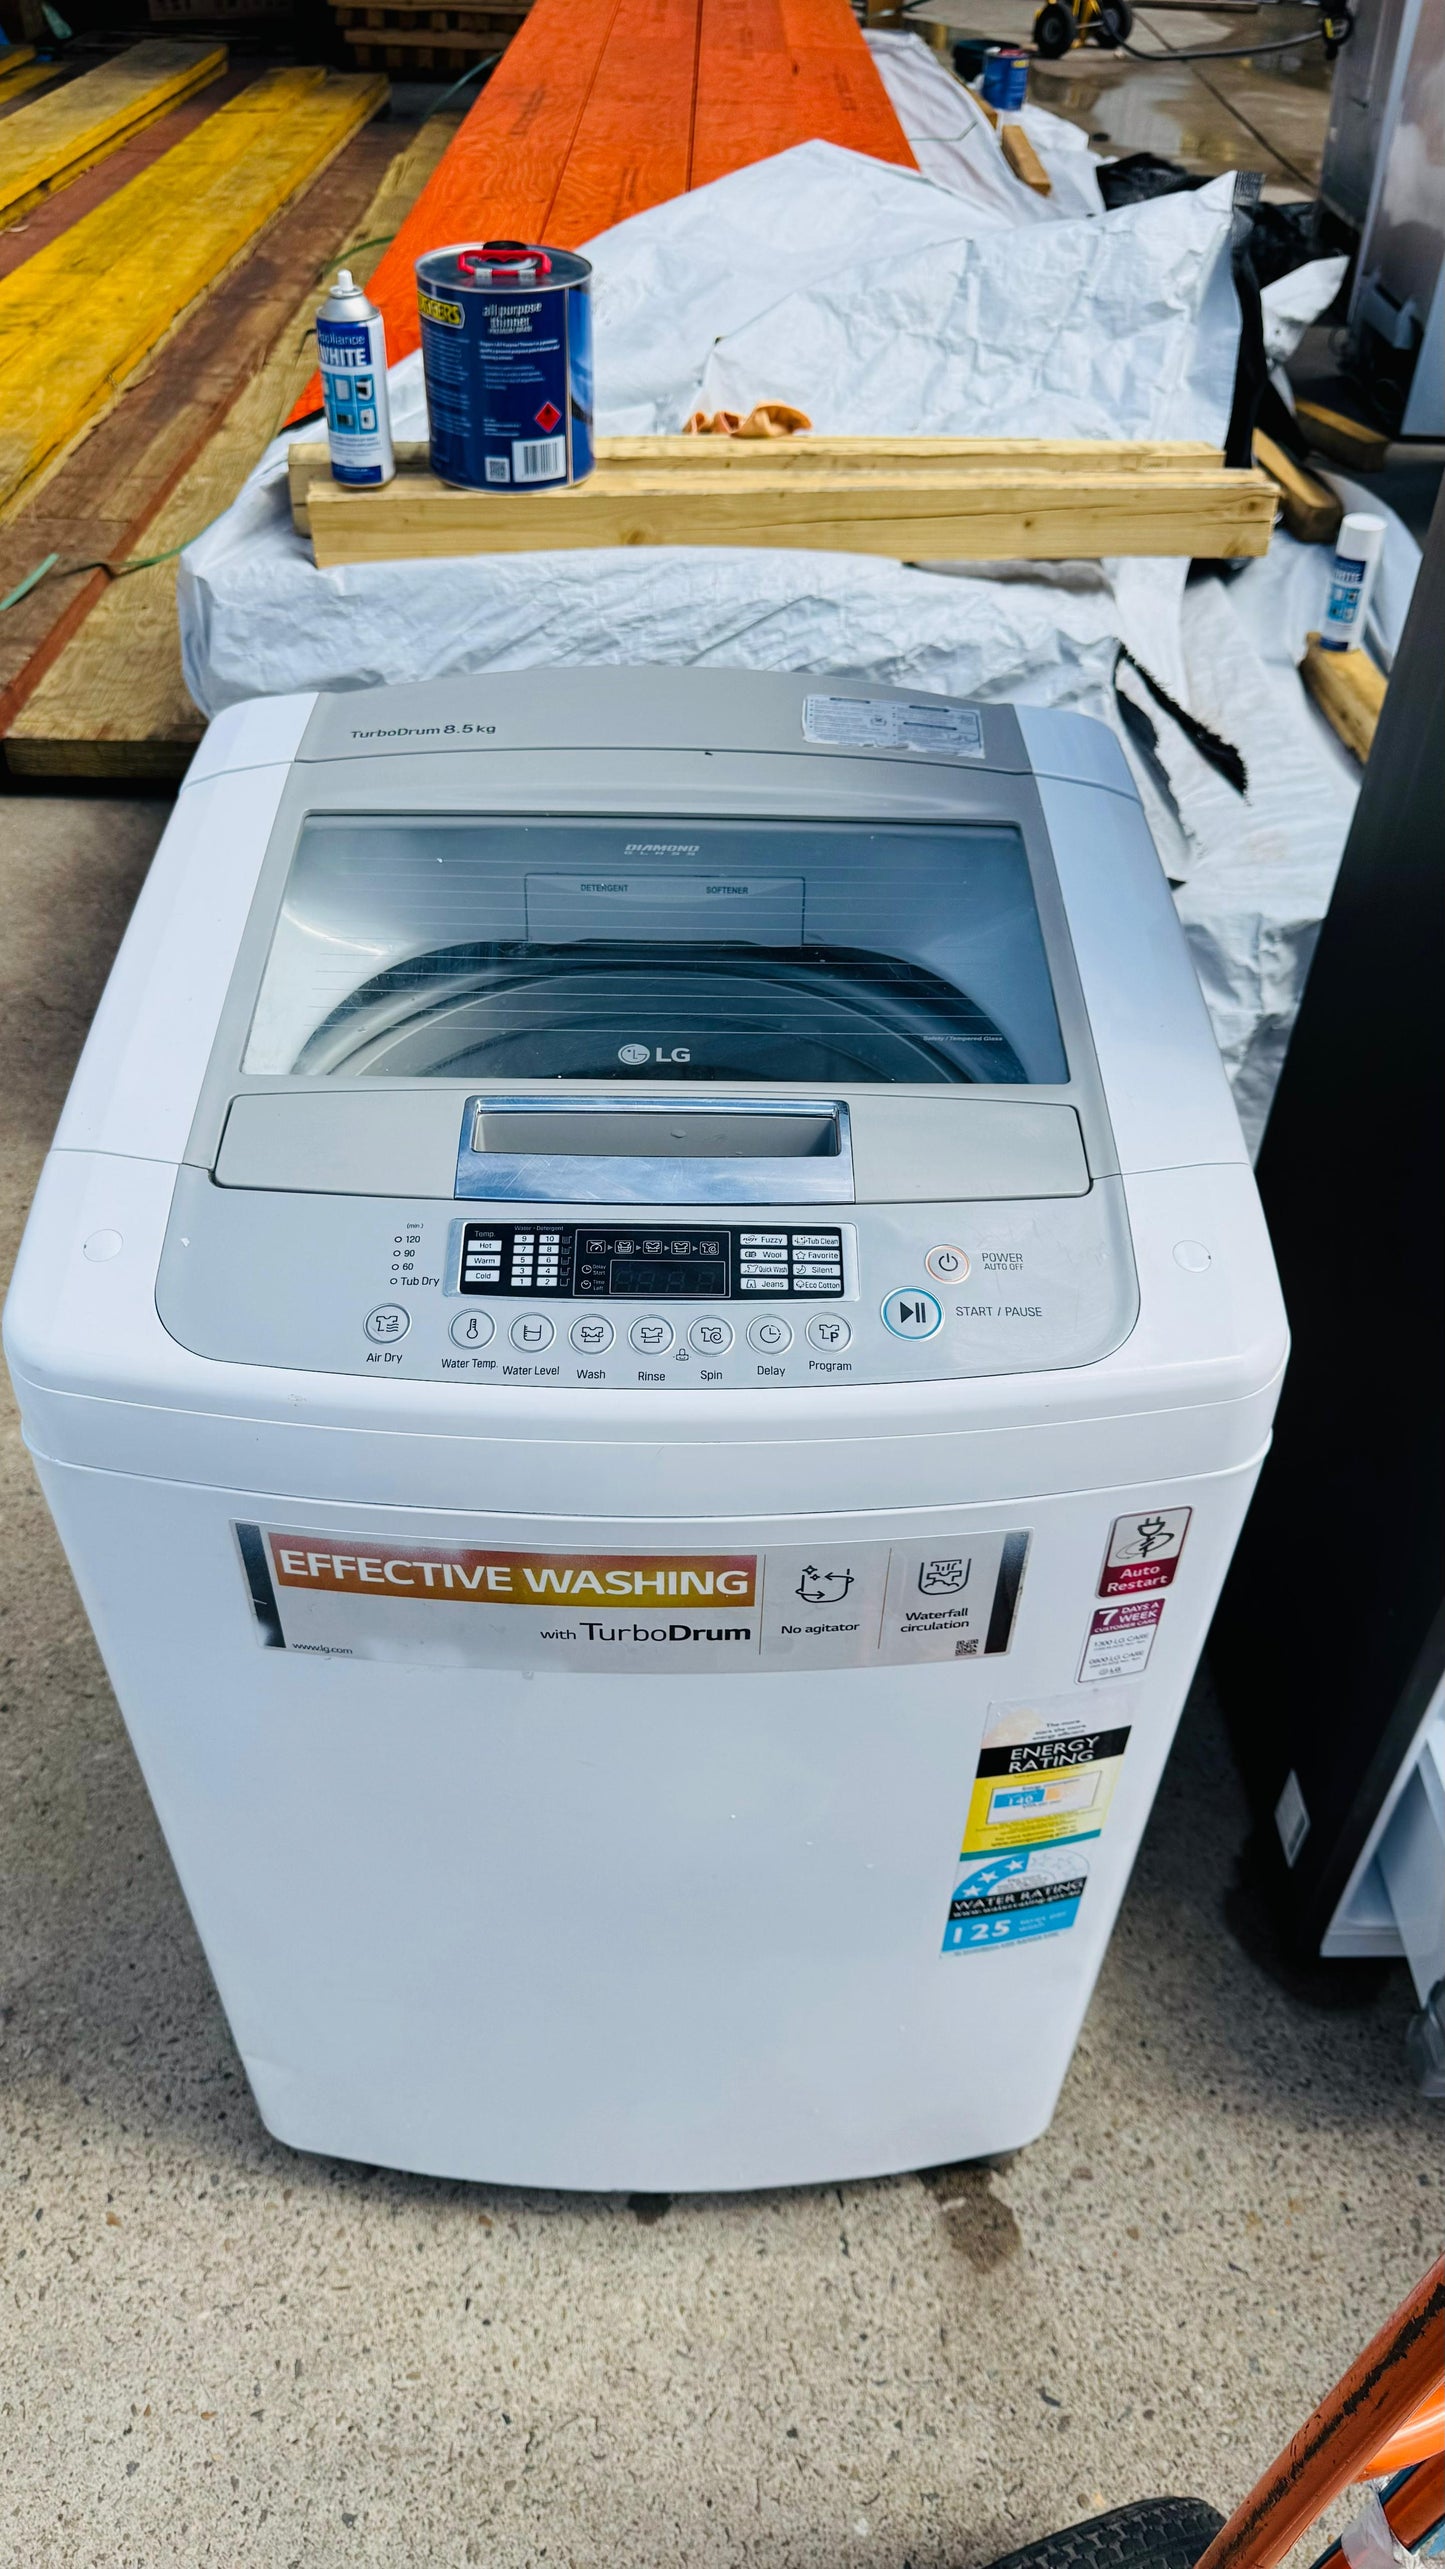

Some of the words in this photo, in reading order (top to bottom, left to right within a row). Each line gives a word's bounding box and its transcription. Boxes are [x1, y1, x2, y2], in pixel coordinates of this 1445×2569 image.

[320, 346, 366, 367] WHITE
[351, 727, 440, 738] TurboDrum
[443, 724, 473, 734] 8.5
[476, 725, 496, 735] kg
[625, 844, 700, 852] DIAMOND
[581, 884, 628, 893] DETERGENT
[706, 886, 748, 895] SOFTENER
[655, 1047, 691, 1063] LG
[761, 1236, 783, 1244] Fuzzy
[808, 1251, 839, 1259] Favorite
[982, 1252, 1024, 1263] POWER
[402, 1262, 414, 1270] 60
[811, 1266, 834, 1274] Silent
[984, 1263, 1008, 1271] AUTO
[1009, 1263, 1024, 1271] OFF
[400, 1276, 420, 1286] Tub
[421, 1276, 440, 1287] Dry
[955, 1306, 993, 1317] START
[1005, 1306, 1043, 1317] PAUSE
[366, 1352, 383, 1363] Air
[384, 1352, 403, 1364] Dry
[441, 1358, 469, 1369] Water
[471, 1358, 499, 1370] Temp.
[502, 1366, 532, 1376] Water
[534, 1366, 560, 1376] Level
[757, 1365, 786, 1377] Delay
[808, 1360, 852, 1372] Program
[576, 1369, 606, 1380] Wash
[637, 1371, 666, 1382] Rinse
[700, 1370, 723, 1381] Spin
[279, 1548, 513, 1592] EFFECTIVE
[522, 1567, 749, 1597] WASHING
[1119, 1565, 1161, 1579] Auto
[1106, 1575, 1168, 1593] Restart
[1121, 1603, 1150, 1614] DAYS
[1150, 1601, 1160, 1609] A
[905, 1607, 968, 1621] Waterfall
[1099, 1608, 1119, 1626] 7
[1118, 1609, 1158, 1623] WEEK
[540, 1629, 576, 1640] with
[579, 1622, 751, 1642] TurboDrum
[781, 1625, 801, 1635] No
[804, 1622, 860, 1635] agitator
[900, 1619, 970, 1633] circulation
[292, 1643, 353, 1654] www.lg.com
[1010, 1735, 1100, 1761] ENERGY
[1008, 1750, 1095, 1773] RATING
[954, 1893, 1016, 1911] WATER
[1020, 1880, 1083, 1900] RATING
[953, 1919, 1012, 1944] 125
